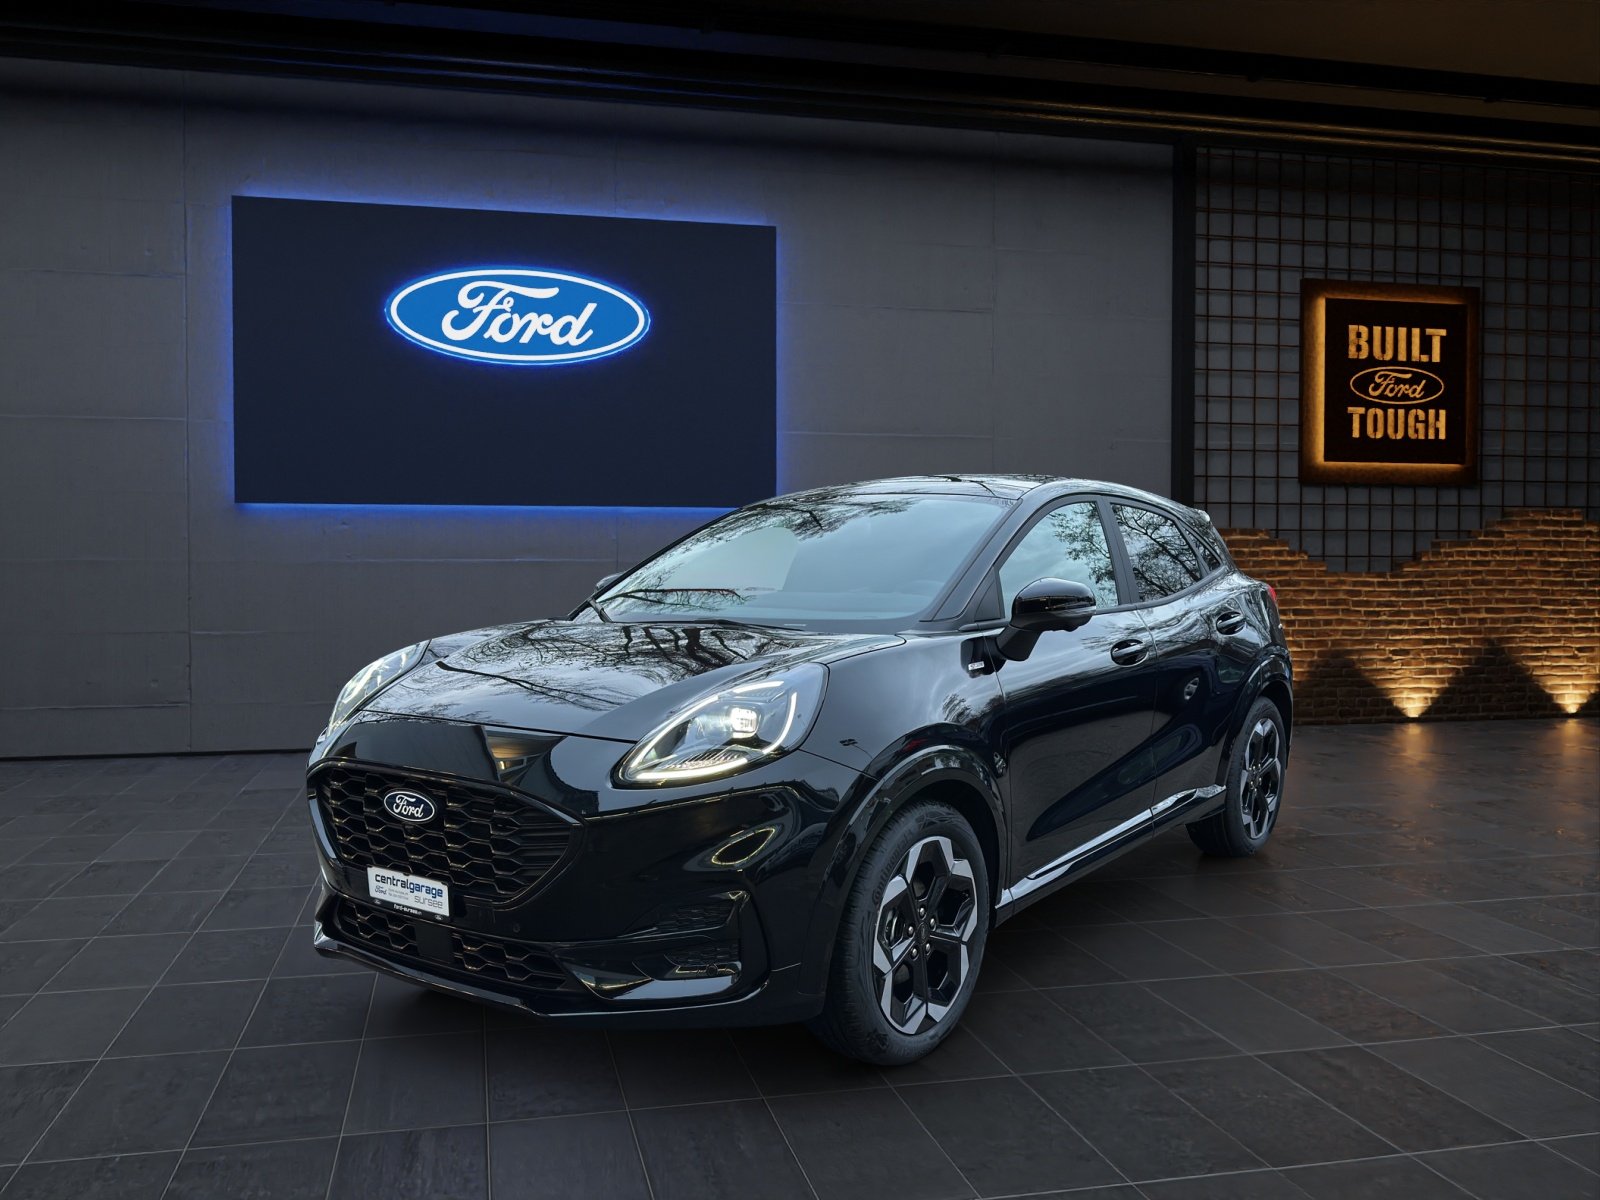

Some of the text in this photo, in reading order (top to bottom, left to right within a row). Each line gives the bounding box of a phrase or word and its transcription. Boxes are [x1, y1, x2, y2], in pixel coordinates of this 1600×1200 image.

[441, 280, 597, 346] Ford
[1347, 324, 1447, 362] BUILT
[1368, 371, 1426, 398] Ford
[1347, 406, 1446, 440] TOUGH
[393, 794, 424, 818] Ford
[374, 873, 443, 899] centralgarage
